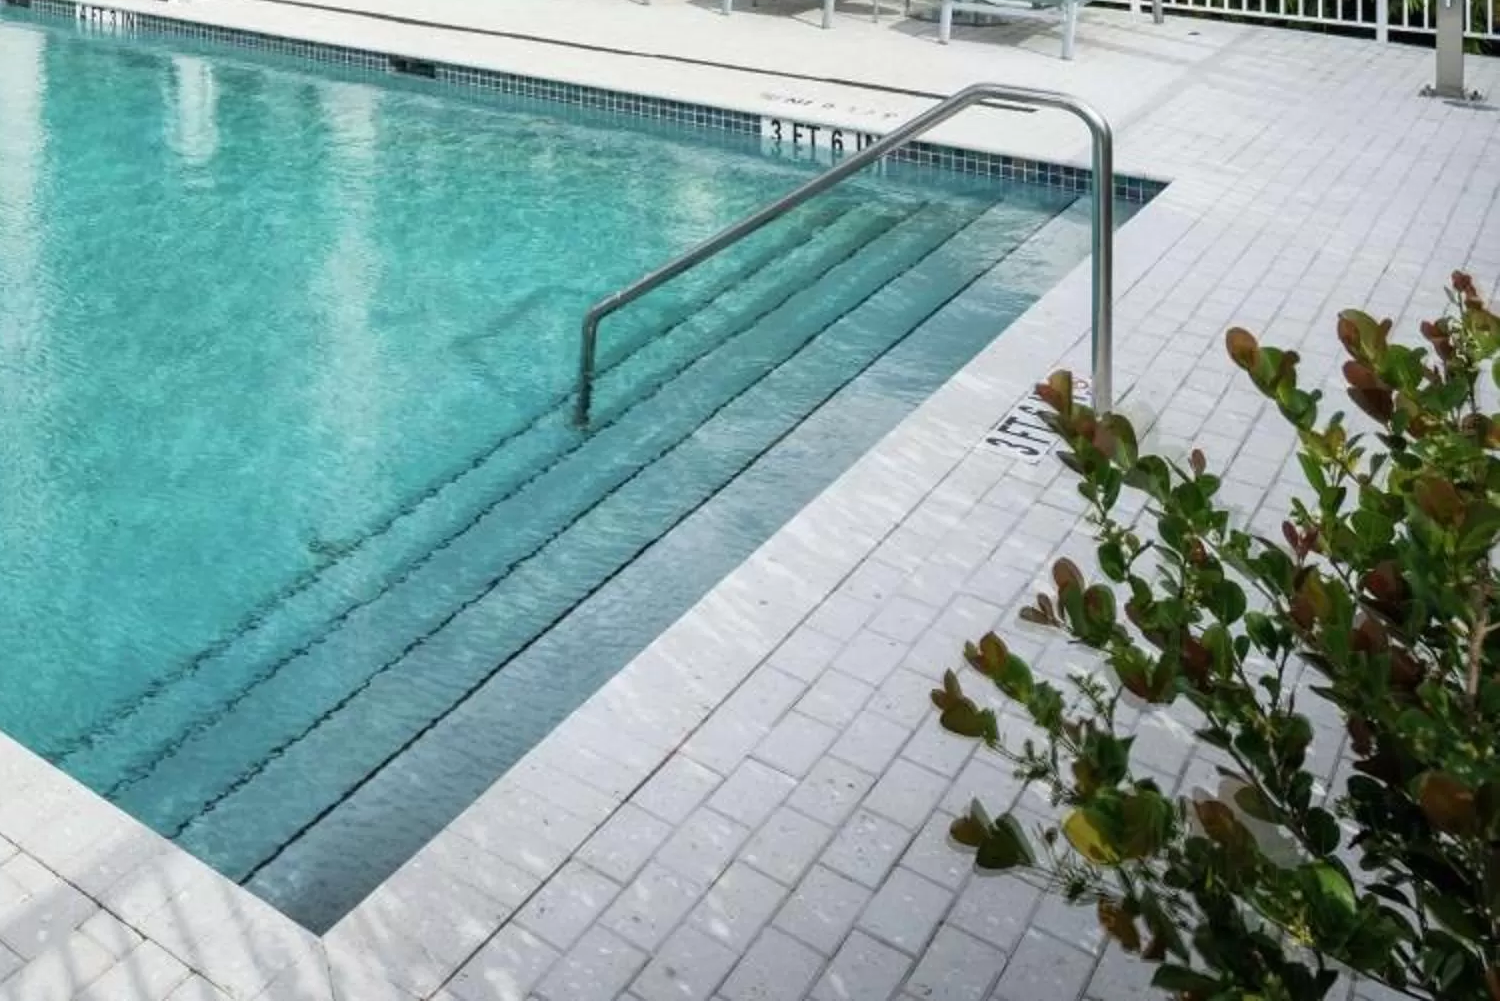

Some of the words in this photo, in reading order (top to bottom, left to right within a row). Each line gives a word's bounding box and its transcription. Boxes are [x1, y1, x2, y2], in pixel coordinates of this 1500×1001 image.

[771, 118, 782, 142] 3
[793, 123, 821, 148] FT
[831, 130, 844, 152] 6
